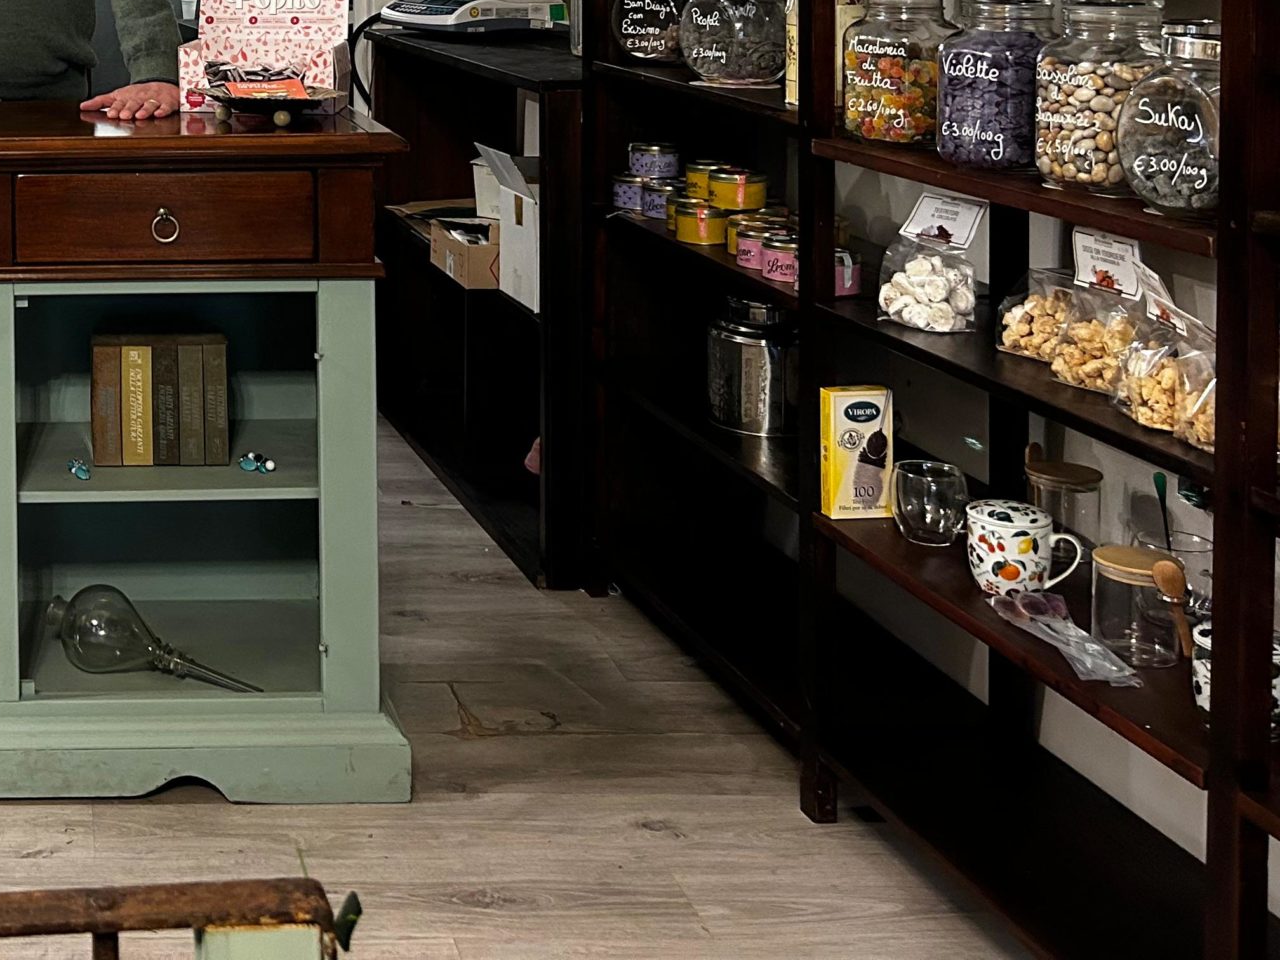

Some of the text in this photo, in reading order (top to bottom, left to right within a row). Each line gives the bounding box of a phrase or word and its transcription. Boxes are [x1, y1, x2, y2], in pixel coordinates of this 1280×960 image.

[848, 36, 907, 57] Macedonia
[861, 59, 876, 71] di
[942, 52, 1000, 82] Violette
[845, 71, 897, 90] Frutta
[941, 120, 1004, 160] €3.00/100g
[1133, 152, 1208, 189] €3.00/100g
[847, 408, 877, 416] VIROPA
[854, 486, 875, 498] 100
